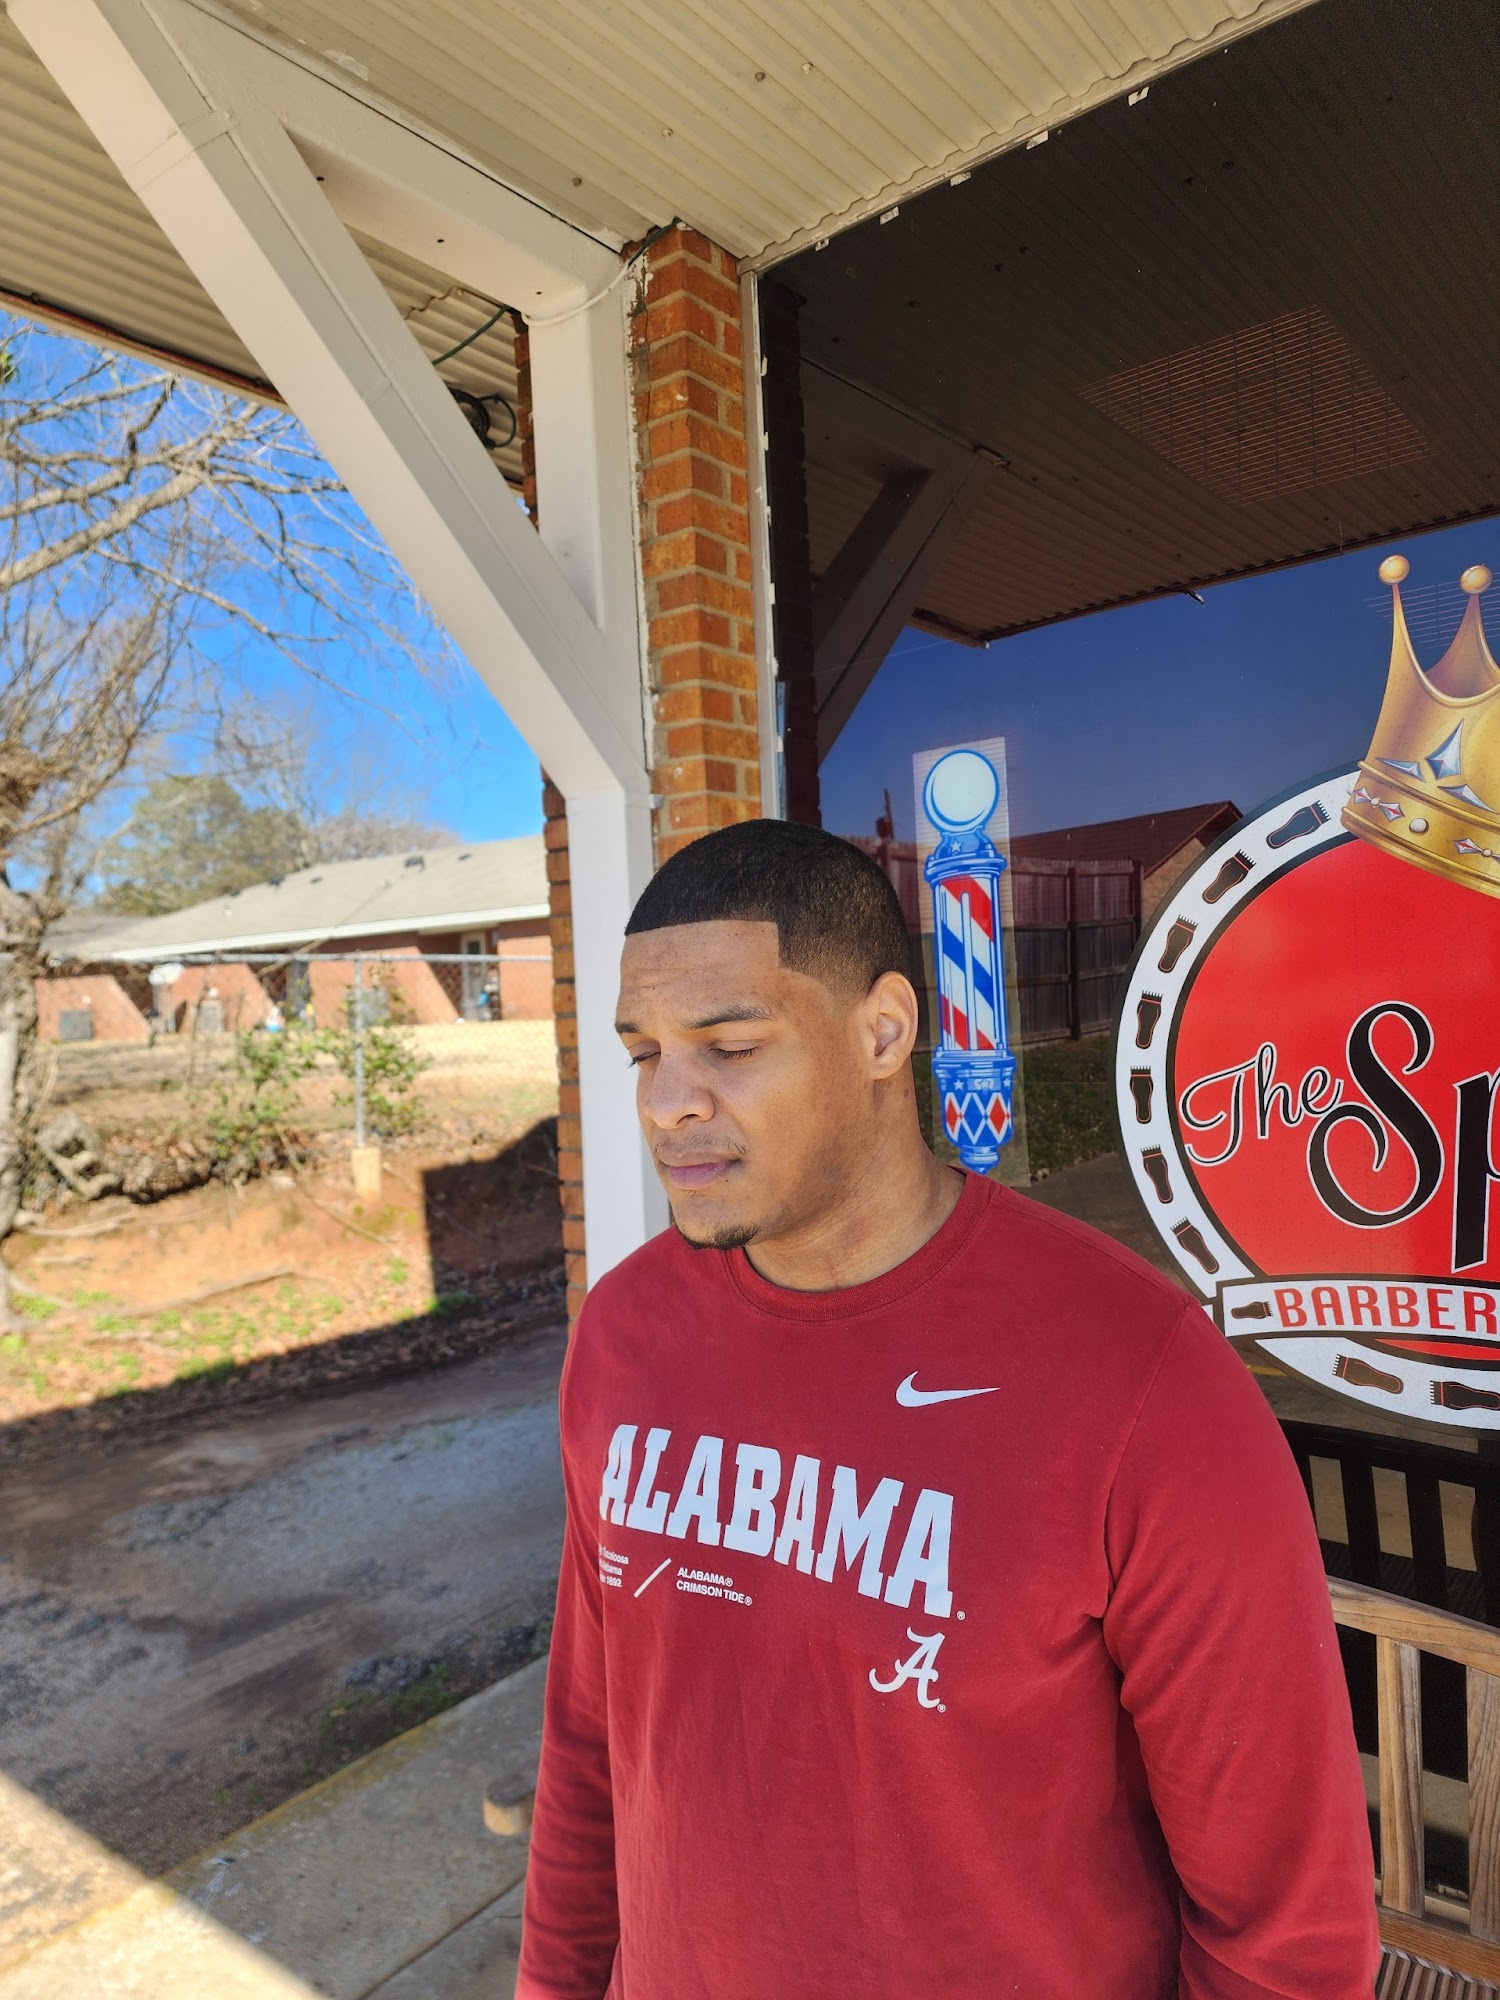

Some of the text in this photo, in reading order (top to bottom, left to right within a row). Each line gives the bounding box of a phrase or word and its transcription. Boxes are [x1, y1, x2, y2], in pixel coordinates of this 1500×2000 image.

[1178, 1041, 1344, 1167] The
[1274, 1285, 1498, 1335] BARBER
[599, 1424, 954, 1619] ALABAMA
[676, 1580, 722, 1598] CRIMSON
